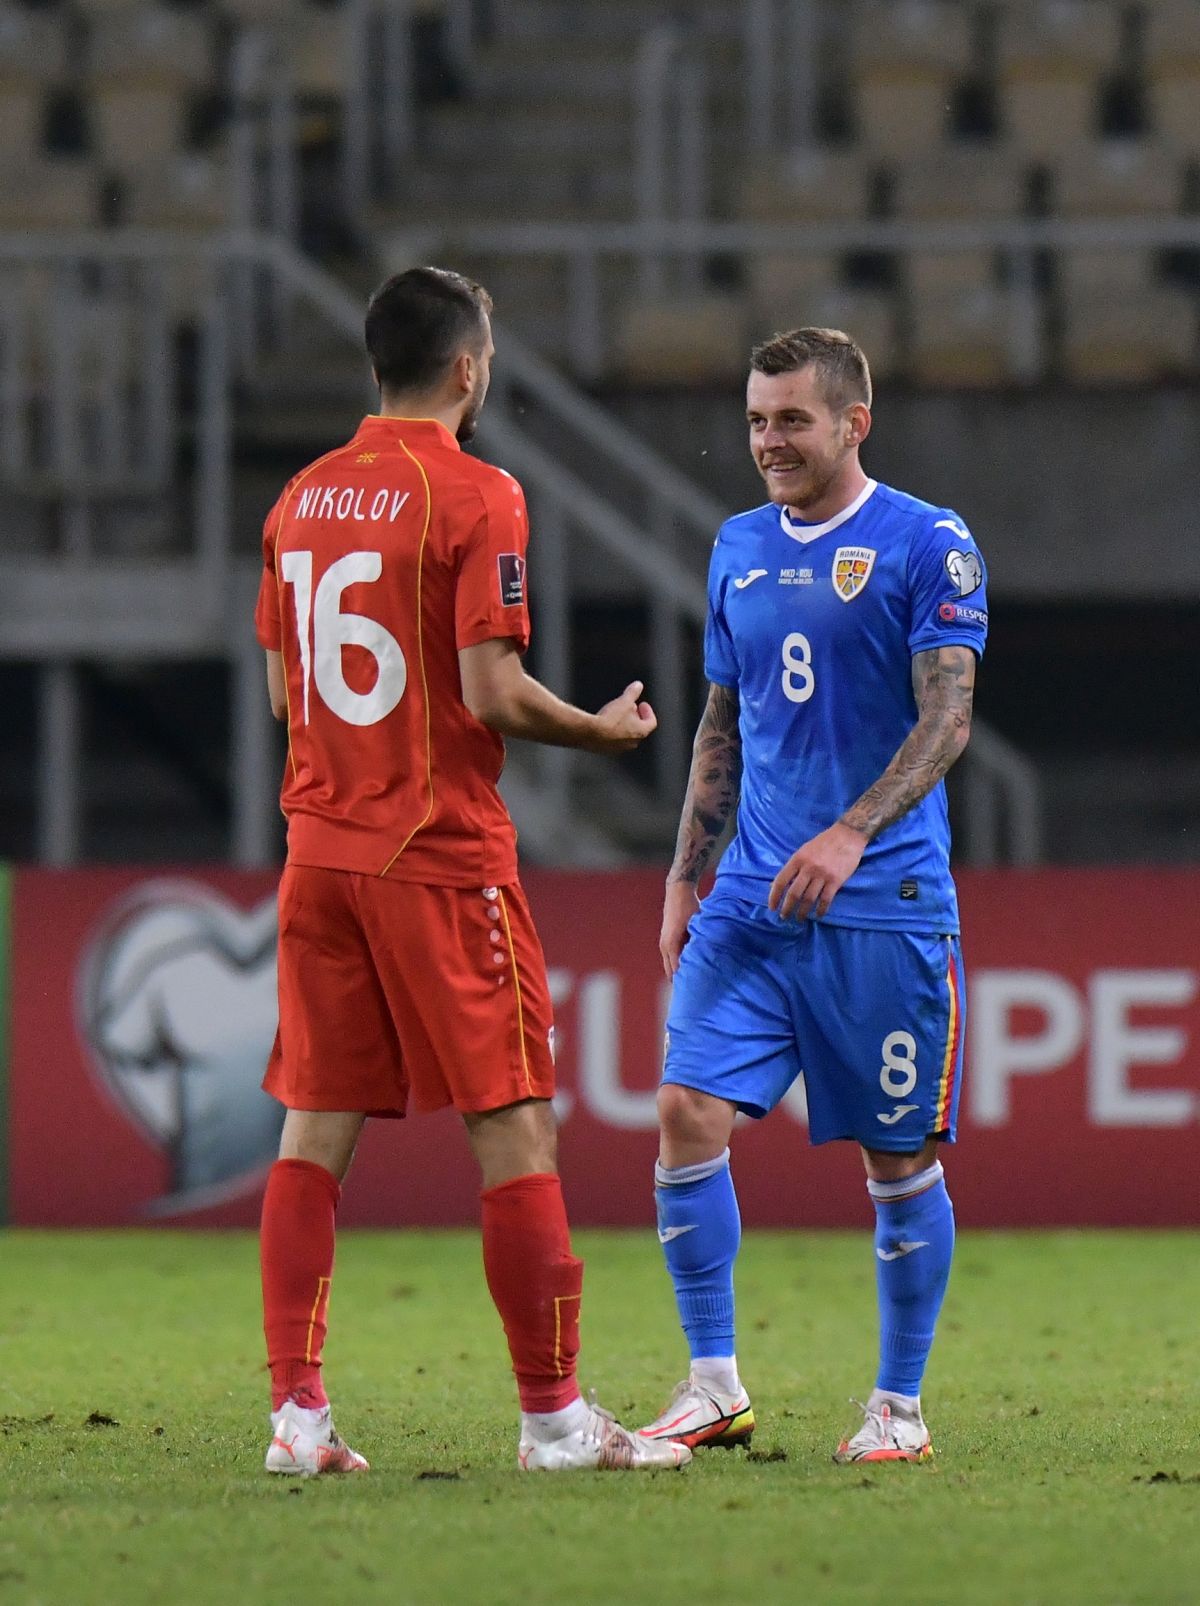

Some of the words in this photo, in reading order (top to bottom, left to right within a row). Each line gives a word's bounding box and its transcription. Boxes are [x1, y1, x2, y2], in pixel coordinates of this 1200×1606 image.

[295, 487, 410, 522] NIKOLOV
[281, 550, 407, 726] 16
[782, 632, 815, 703] 8
[880, 1030, 917, 1098] 8
